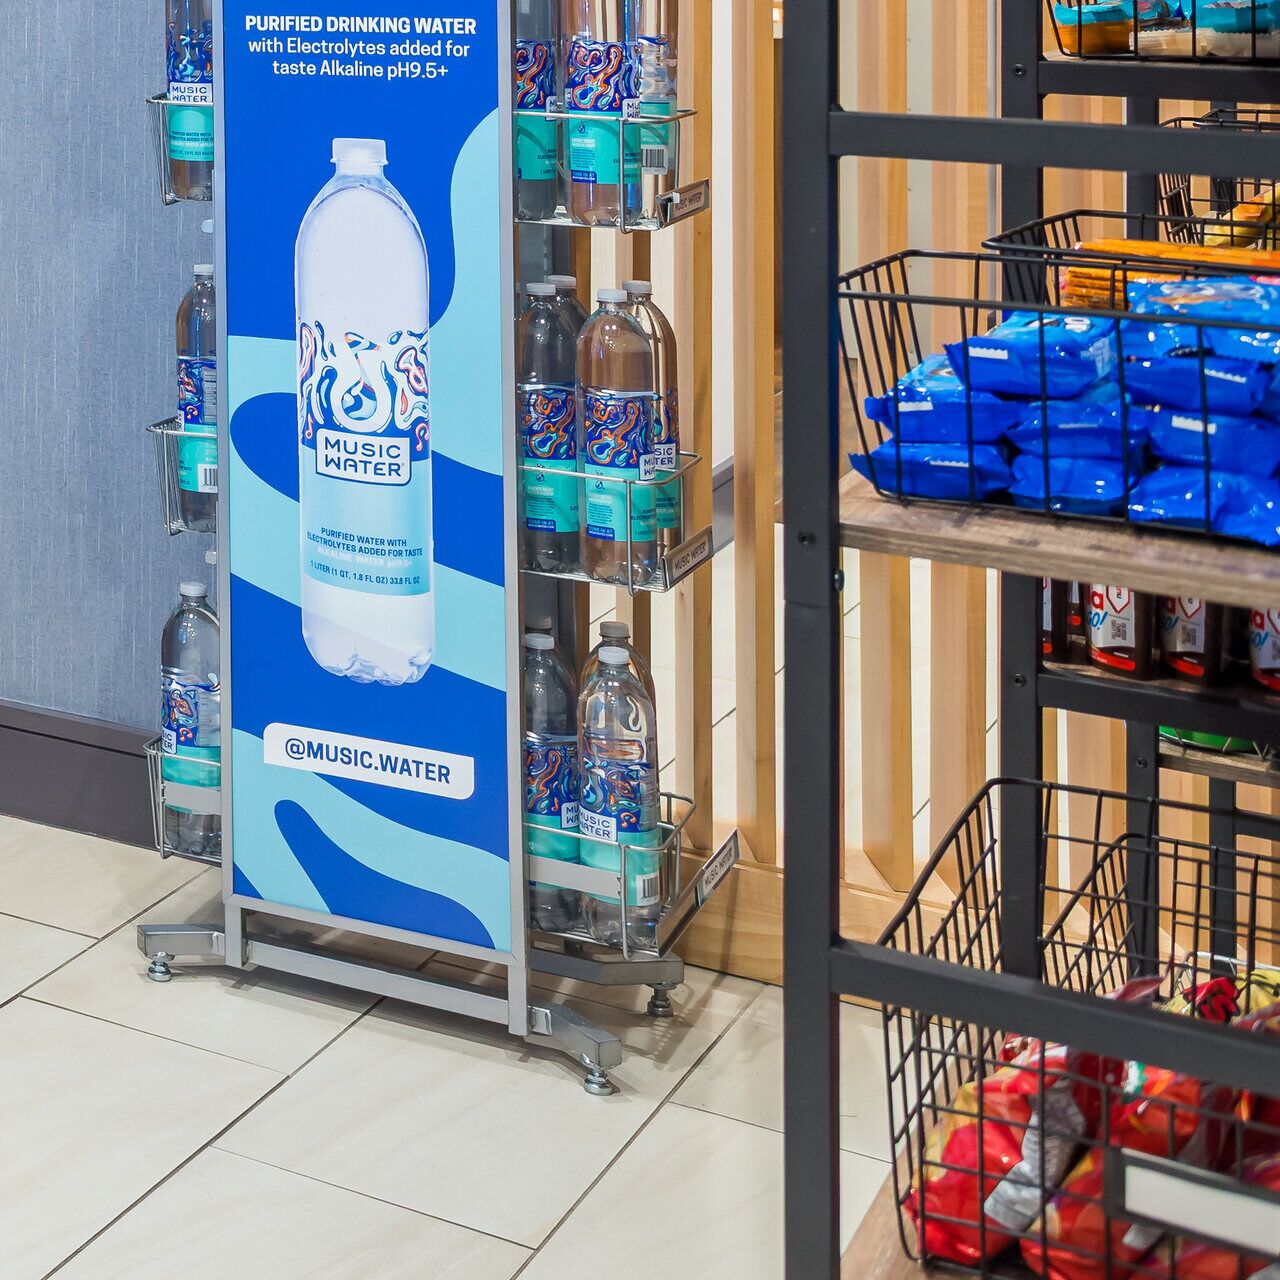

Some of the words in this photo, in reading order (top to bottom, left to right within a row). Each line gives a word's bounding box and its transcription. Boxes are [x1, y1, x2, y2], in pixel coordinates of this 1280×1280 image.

[245, 14, 323, 33] PURIFIED
[326, 15, 411, 34] DRINKING
[414, 17, 477, 35] WATER
[247, 37, 284, 53] with
[286, 37, 386, 58] Electrolytes
[389, 39, 442, 57] added
[445, 39, 470, 57] for
[272, 60, 317, 76] taste
[319, 59, 384, 77] Alkaline
[386, 61, 449, 80] pH9.5+
[172, 85, 207, 94] MUSIC
[172, 94, 208, 103] WATER
[324, 436, 401, 459] MUSIC
[306, 530, 357, 553] ELECTROLYTES
[357, 545, 387, 557] ADDED
[387, 547, 403, 558] FOR
[404, 546, 424, 558] TASTE
[320, 527, 355, 543] PURIFIED
[356, 534, 386, 547] WATER
[386, 538, 407, 548] WITH
[354, 554, 385, 567] WATER
[313, 561, 331, 574] LITER
[353, 572, 364, 582] 1.8
[364, 574, 374, 583] FL
[284, 737, 451, 784] @MUSIC.WATER
